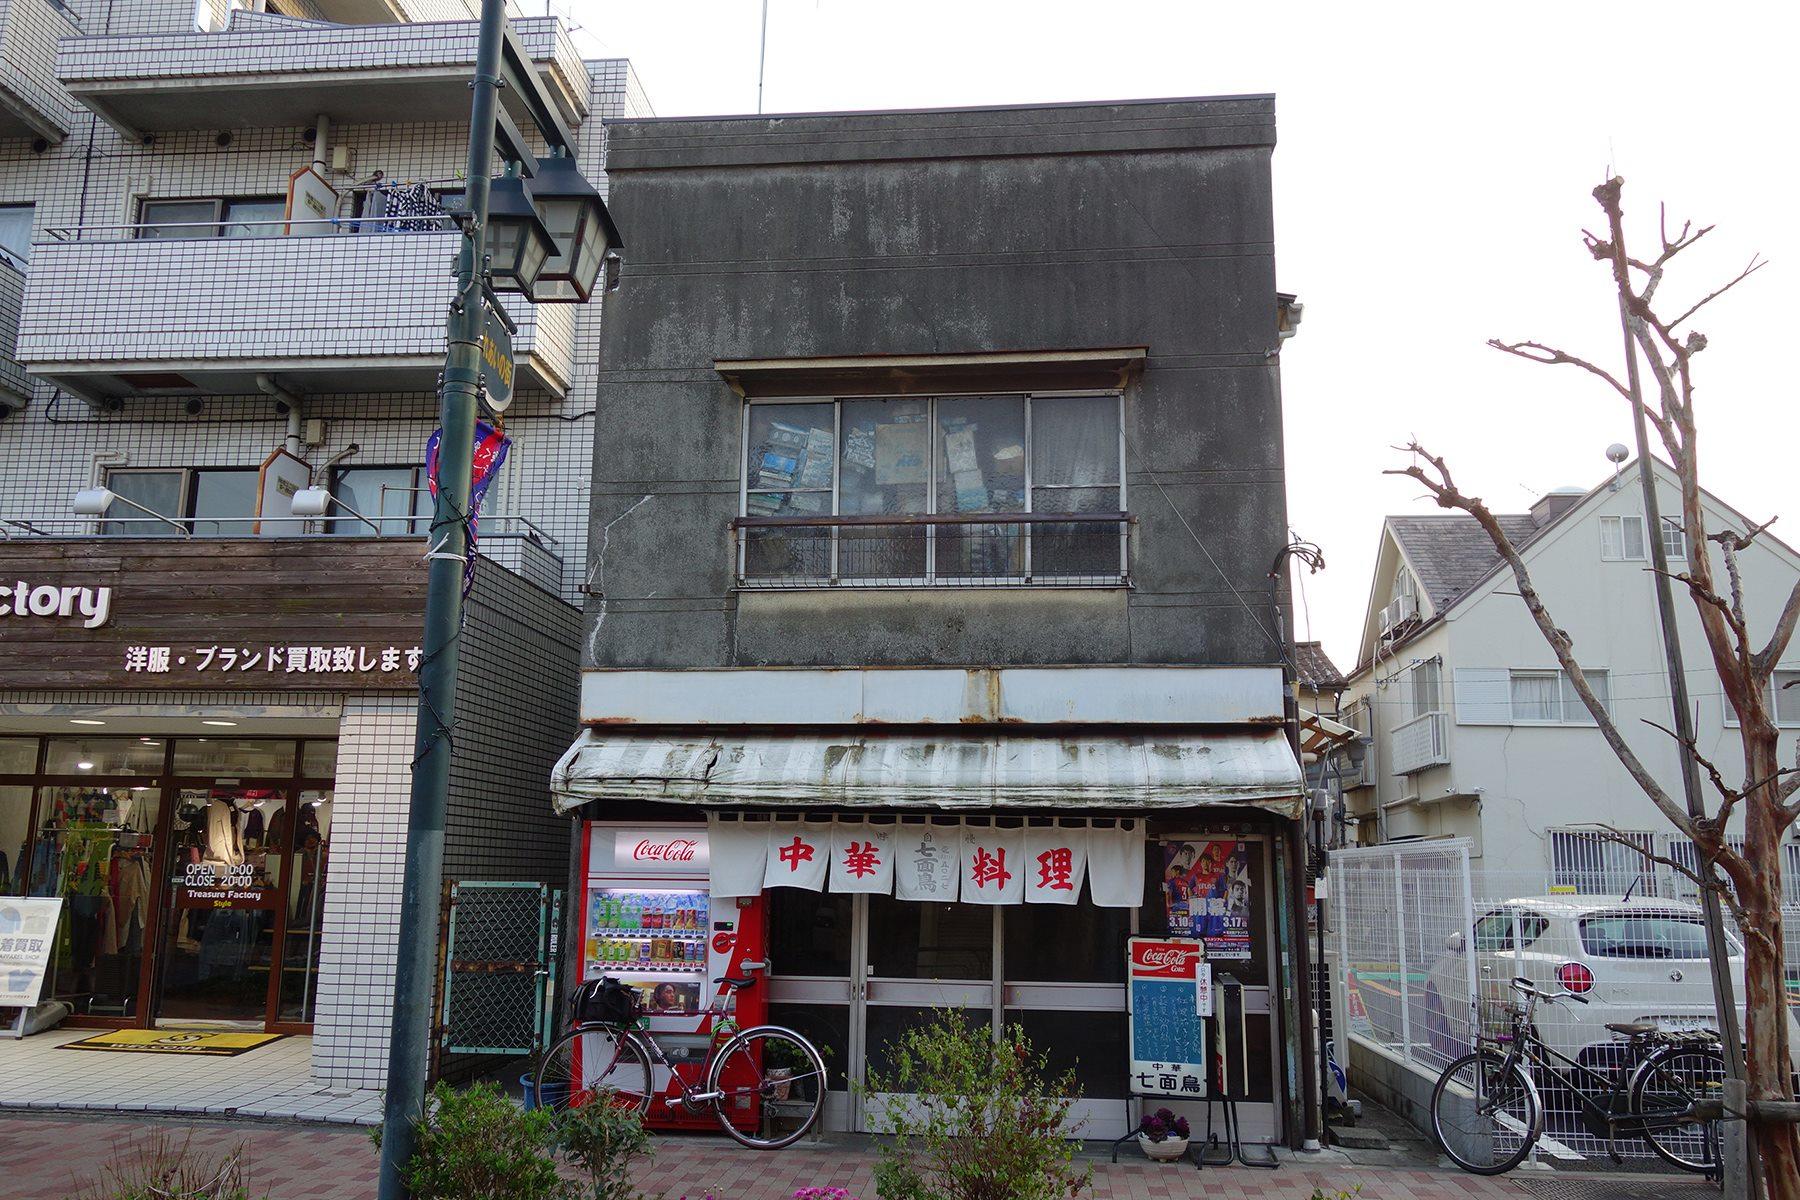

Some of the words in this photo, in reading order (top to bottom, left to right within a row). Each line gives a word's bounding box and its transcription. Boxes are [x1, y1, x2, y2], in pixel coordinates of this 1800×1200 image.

[125, 646, 424, 673] 洋服・ブランド買取致します
[633, 839, 698, 861] Coca-Cola
[186, 864, 215, 875] OPEN
[224, 864, 254, 875] 10:00
[185, 875, 215, 887] CLOSE
[221, 876, 252, 887] 20:00
[188, 889, 226, 899] Treasure
[227, 890, 262, 901] Factory
[213, 900, 232, 908] Style
[1223, 916, 1242, 928] 3.17
[1142, 948, 1187, 966] Coca-Cola
[1136, 1071, 1201, 1094] 七面鳥
